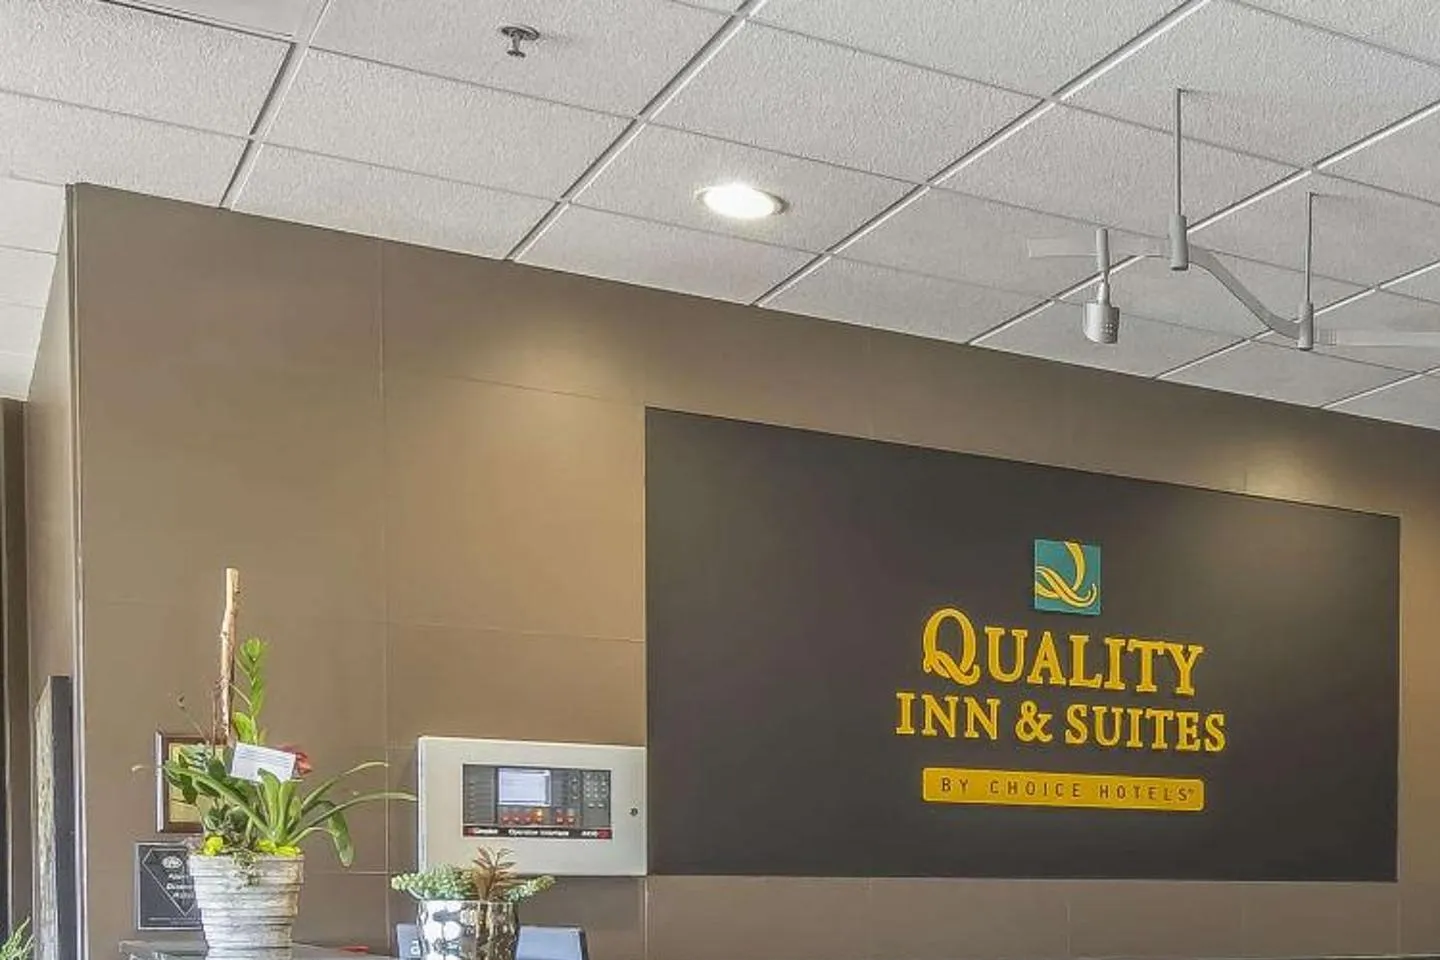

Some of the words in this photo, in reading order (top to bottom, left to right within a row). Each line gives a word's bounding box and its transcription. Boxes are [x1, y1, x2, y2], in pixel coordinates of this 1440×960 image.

[922, 607, 1204, 696] QUALITY
[895, 691, 1001, 740] INN
[1014, 700, 1053, 743] &
[1064, 703, 1227, 752] SUITES
[941, 777, 969, 793] BY
[989, 780, 1082, 798] CHOICE
